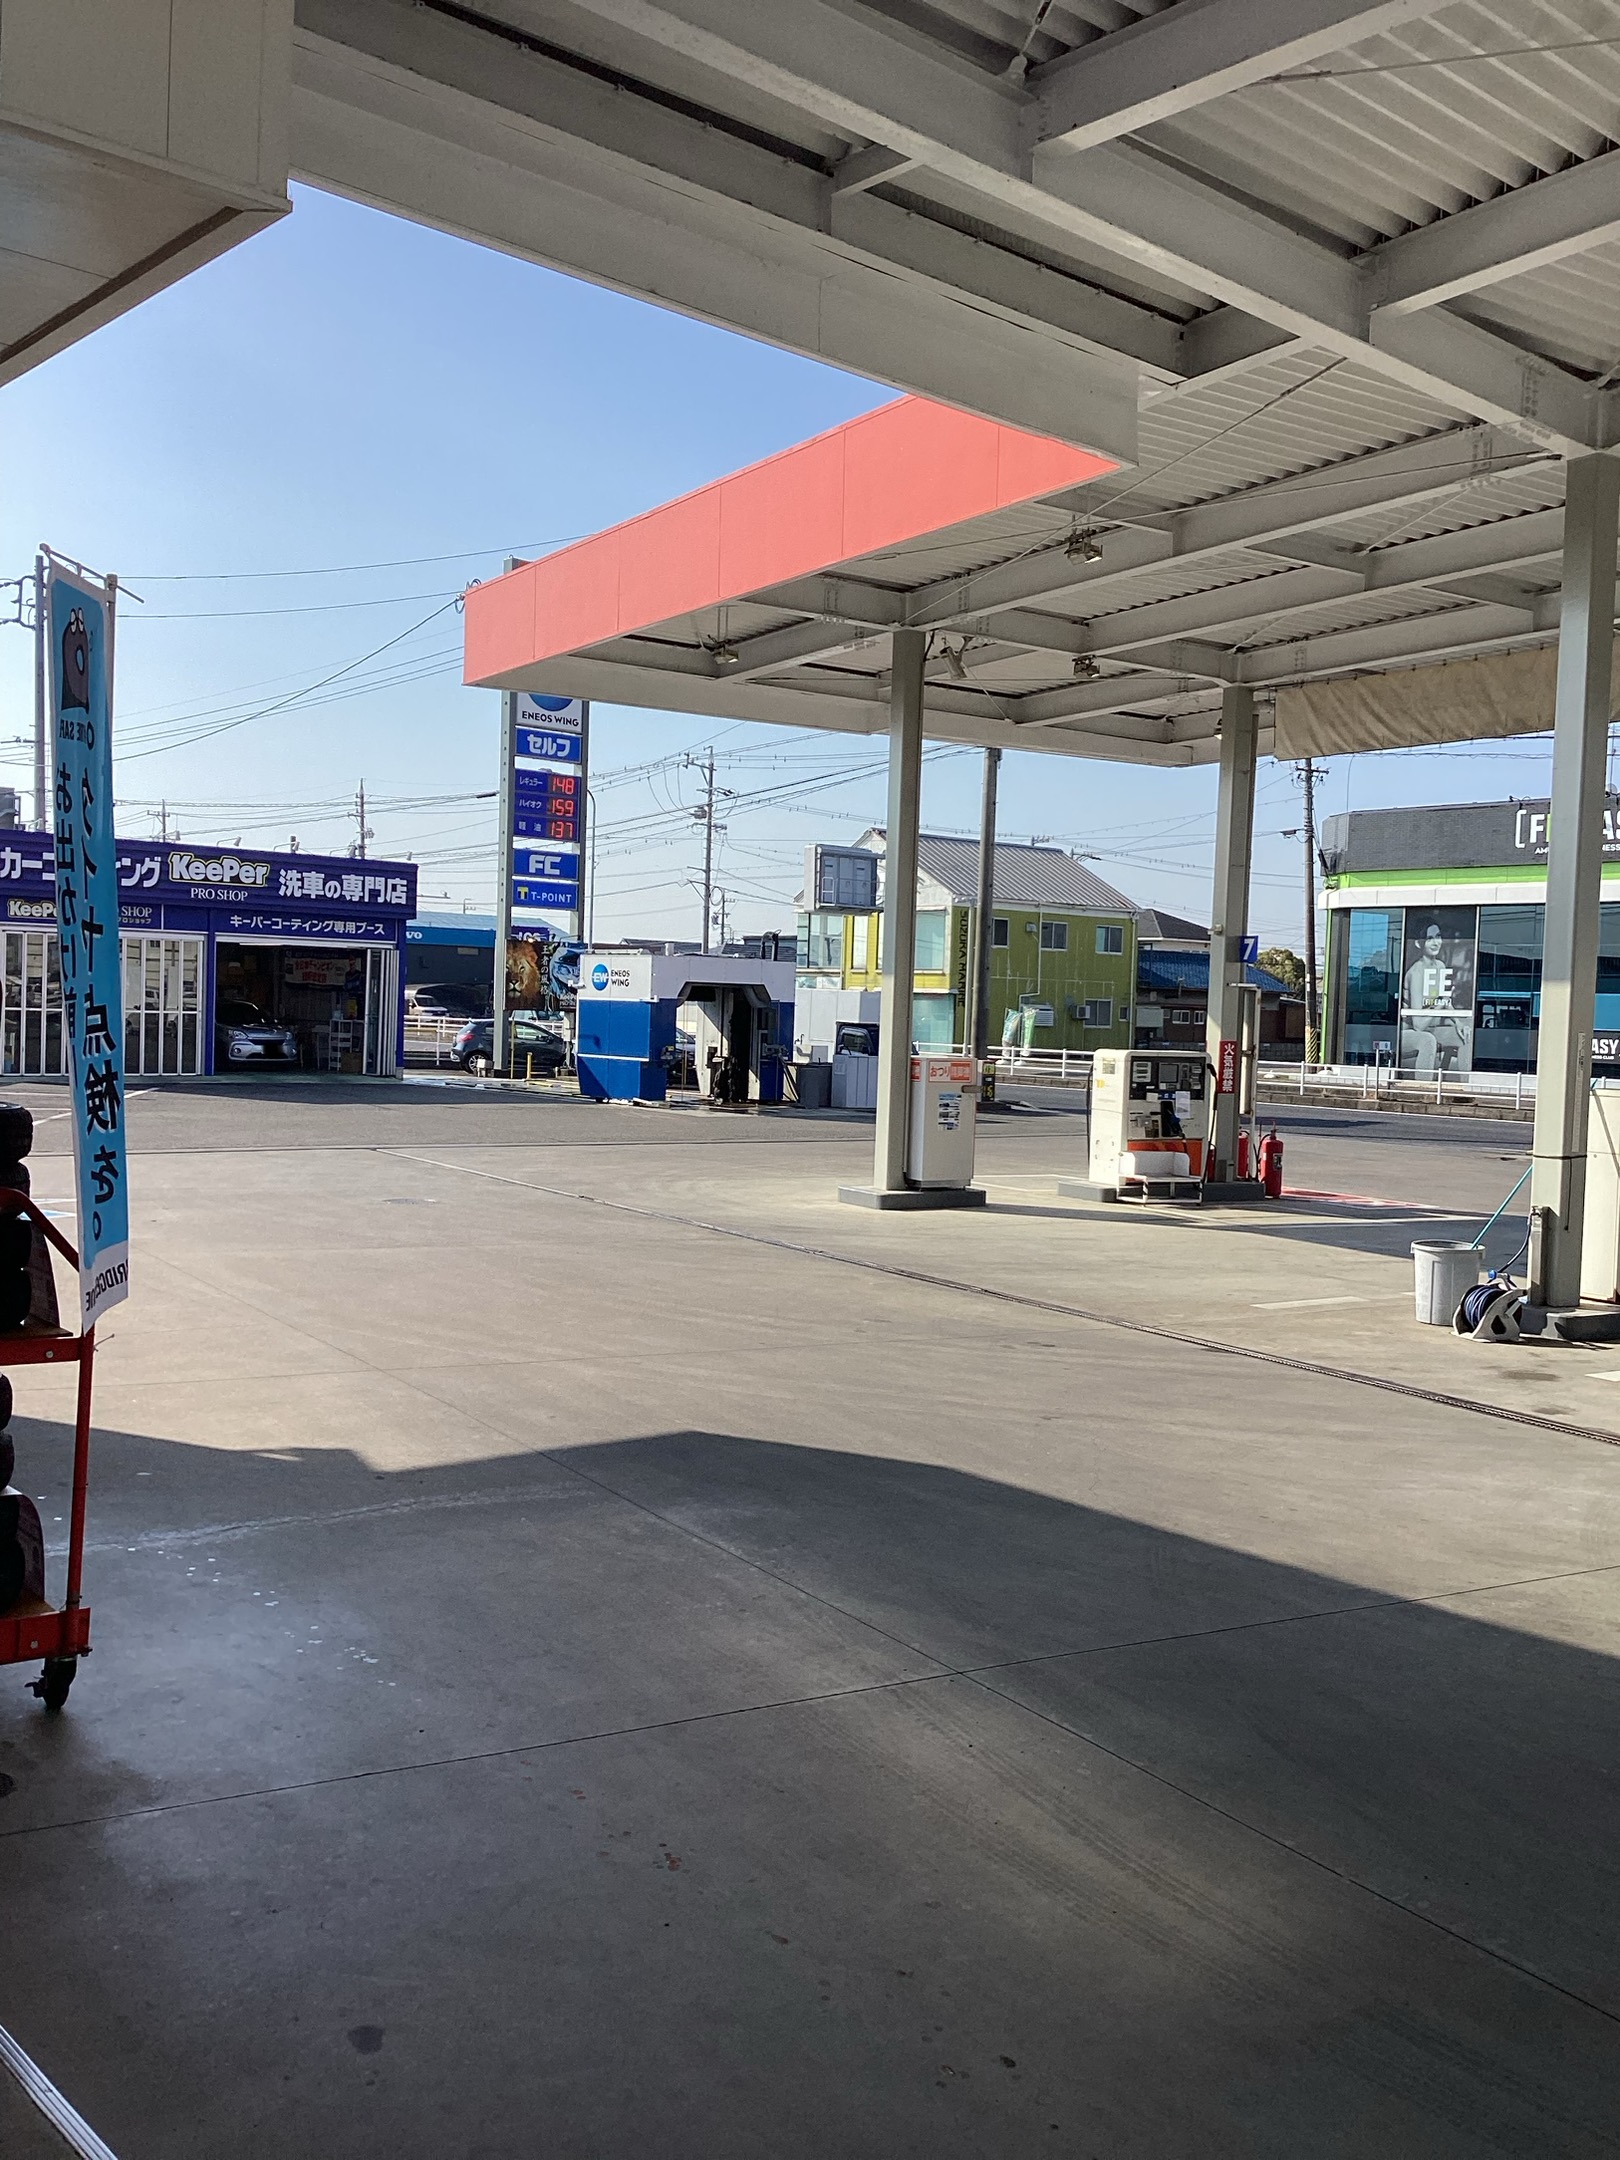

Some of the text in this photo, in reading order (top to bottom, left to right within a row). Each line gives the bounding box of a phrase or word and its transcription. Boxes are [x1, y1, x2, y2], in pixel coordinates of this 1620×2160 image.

[522, 711, 579, 727] ENEOS WING
[527, 734, 571, 757] セルフ
[519, 776, 575, 795] レギュラー 148
[519, 798, 574, 817] ハイオク 159
[551, 821, 574, 838] 137
[170, 853, 269, 886] KeePer
[528, 854, 562, 876] FC
[190, 888, 248, 901] PRO SHOP
[278, 868, 408, 905] 洗車の専門店
[531, 891, 572, 903] T-POINT
[121, 906, 152, 918] SHOP
[229, 915, 385, 935] キーパーコーティング専用ブース
[1243, 938, 1255, 960] 7
[611, 969, 630, 978] ENEOS
[611, 978, 630, 987] WING
[1423, 969, 1453, 996] FE
[1591, 1038, 1619, 1055] ASY
[1222, 1042, 1235, 1092] 火気厳禁
